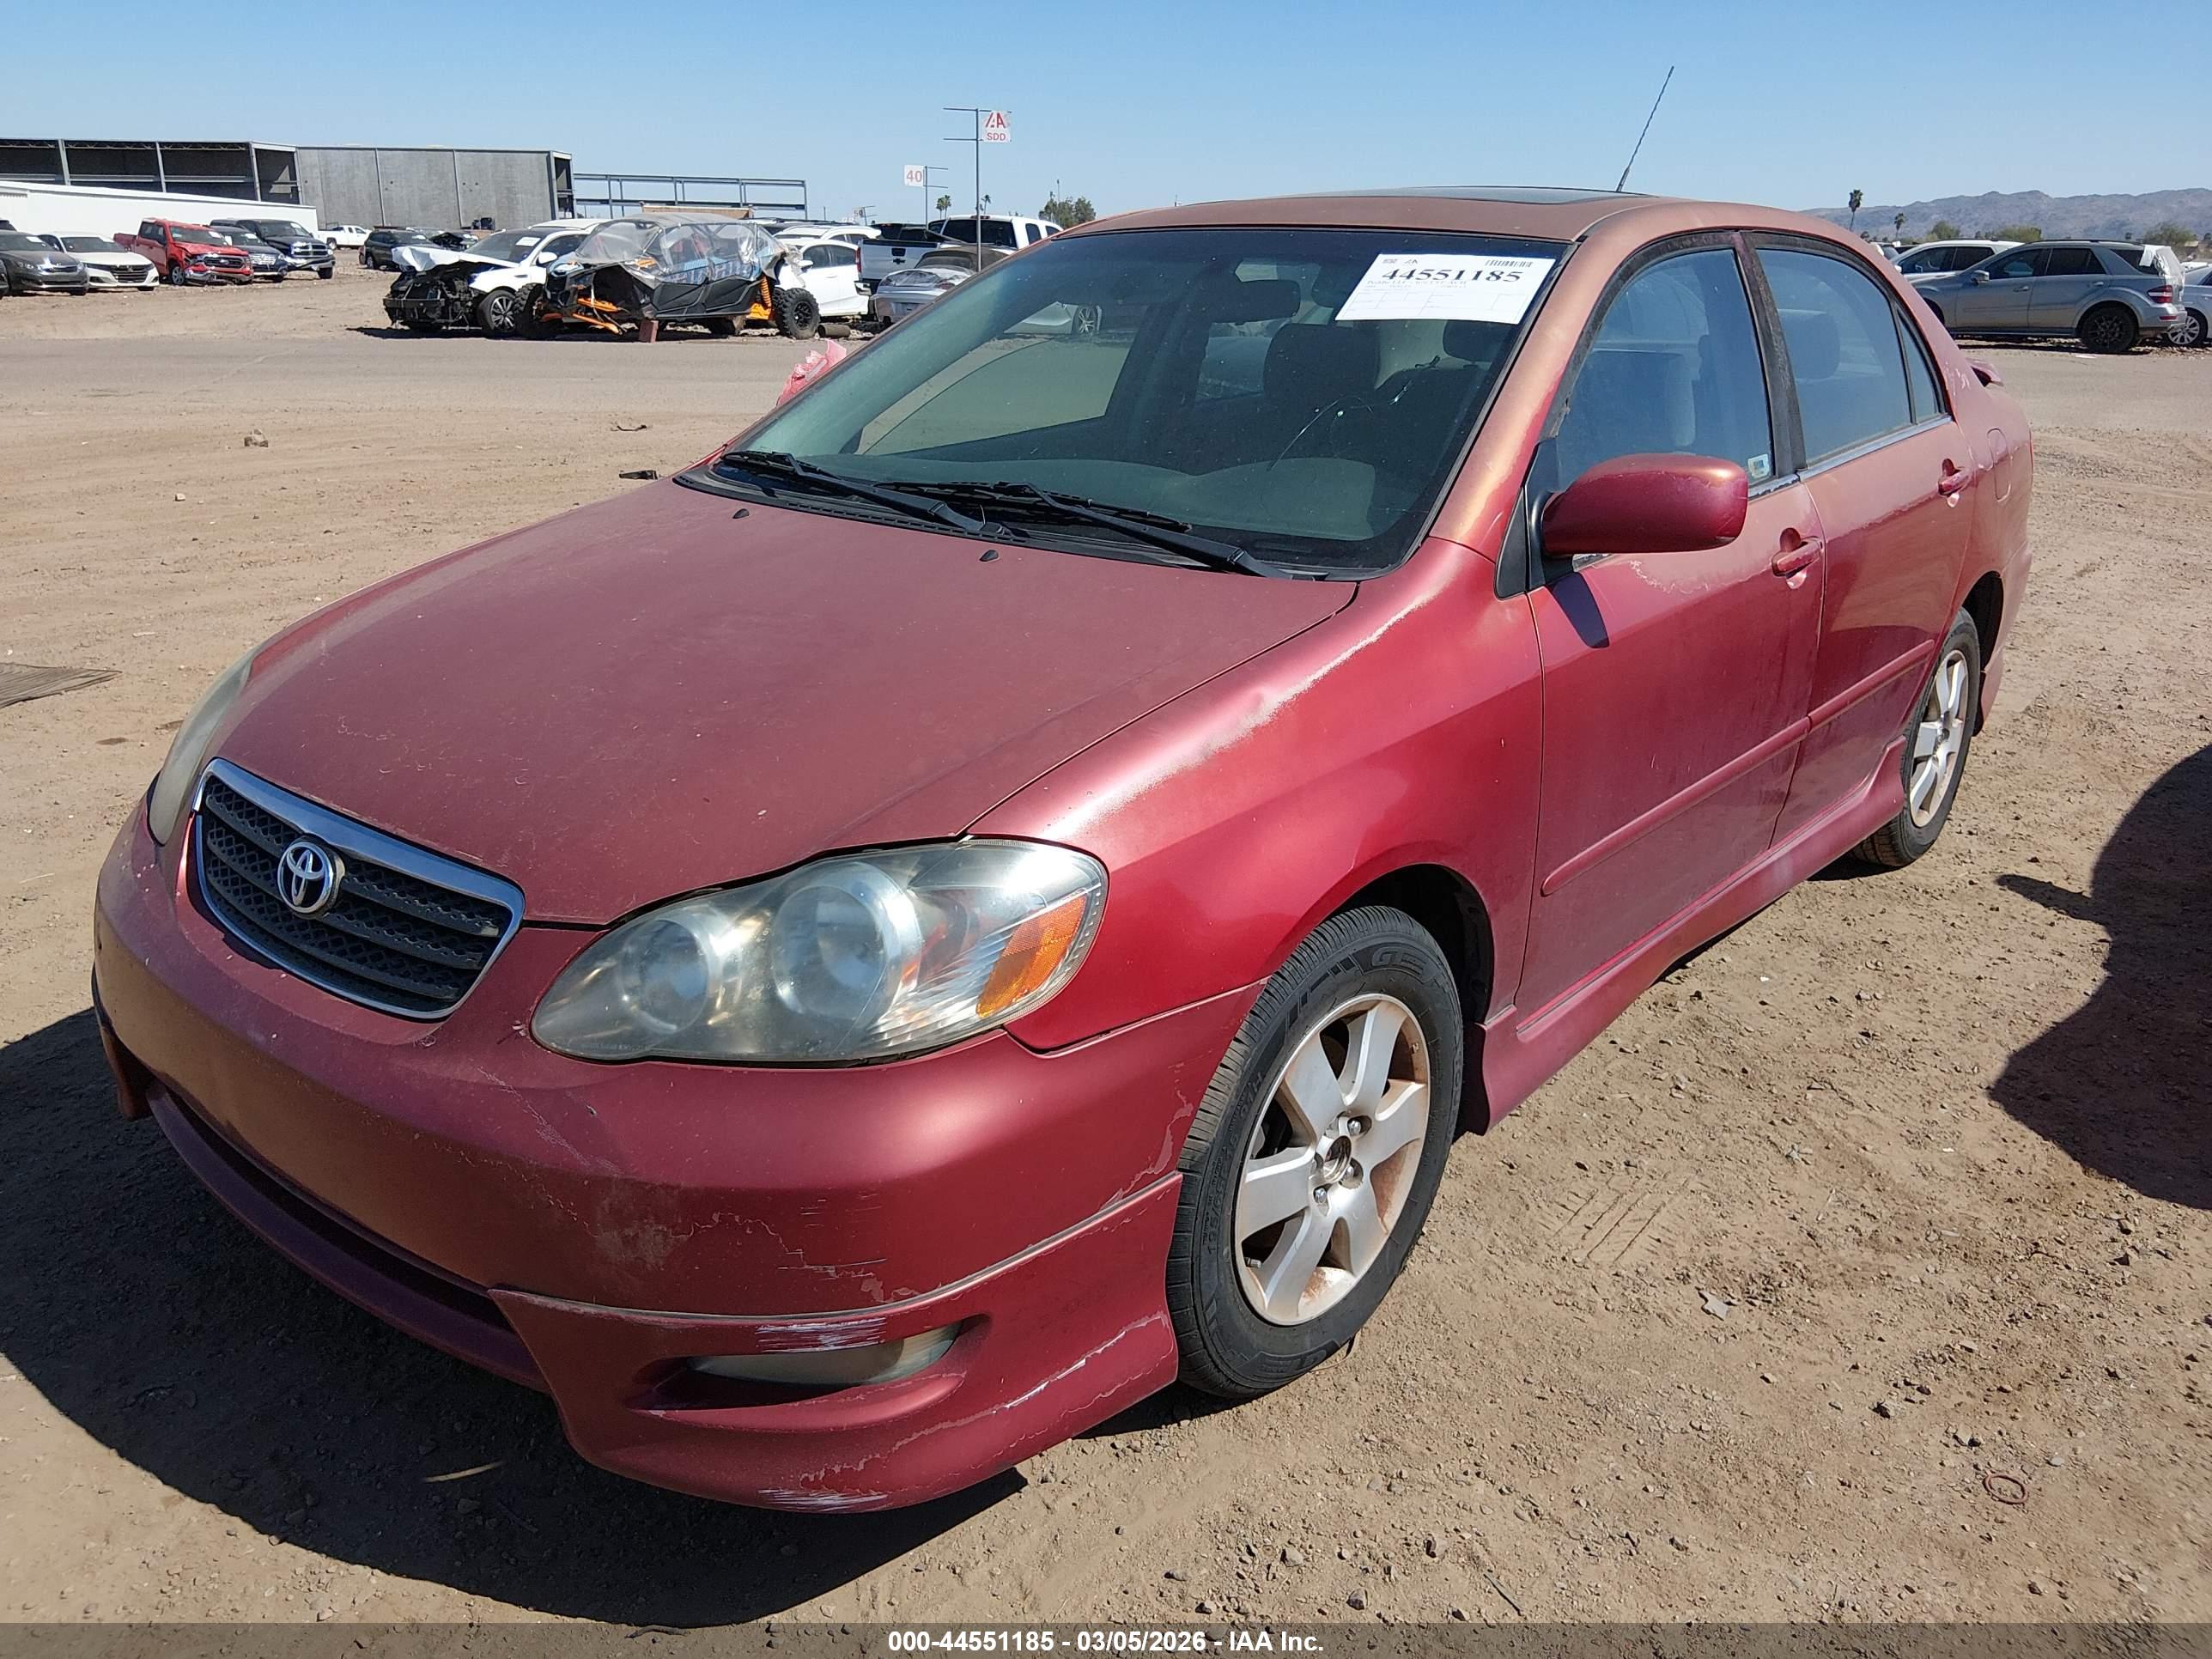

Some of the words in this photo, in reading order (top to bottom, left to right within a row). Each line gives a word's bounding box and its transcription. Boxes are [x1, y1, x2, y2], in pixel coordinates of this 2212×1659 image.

[988, 132, 1006, 141] SDD
[907, 170, 922, 182] 40
[1382, 268, 1523, 282] 44551185
